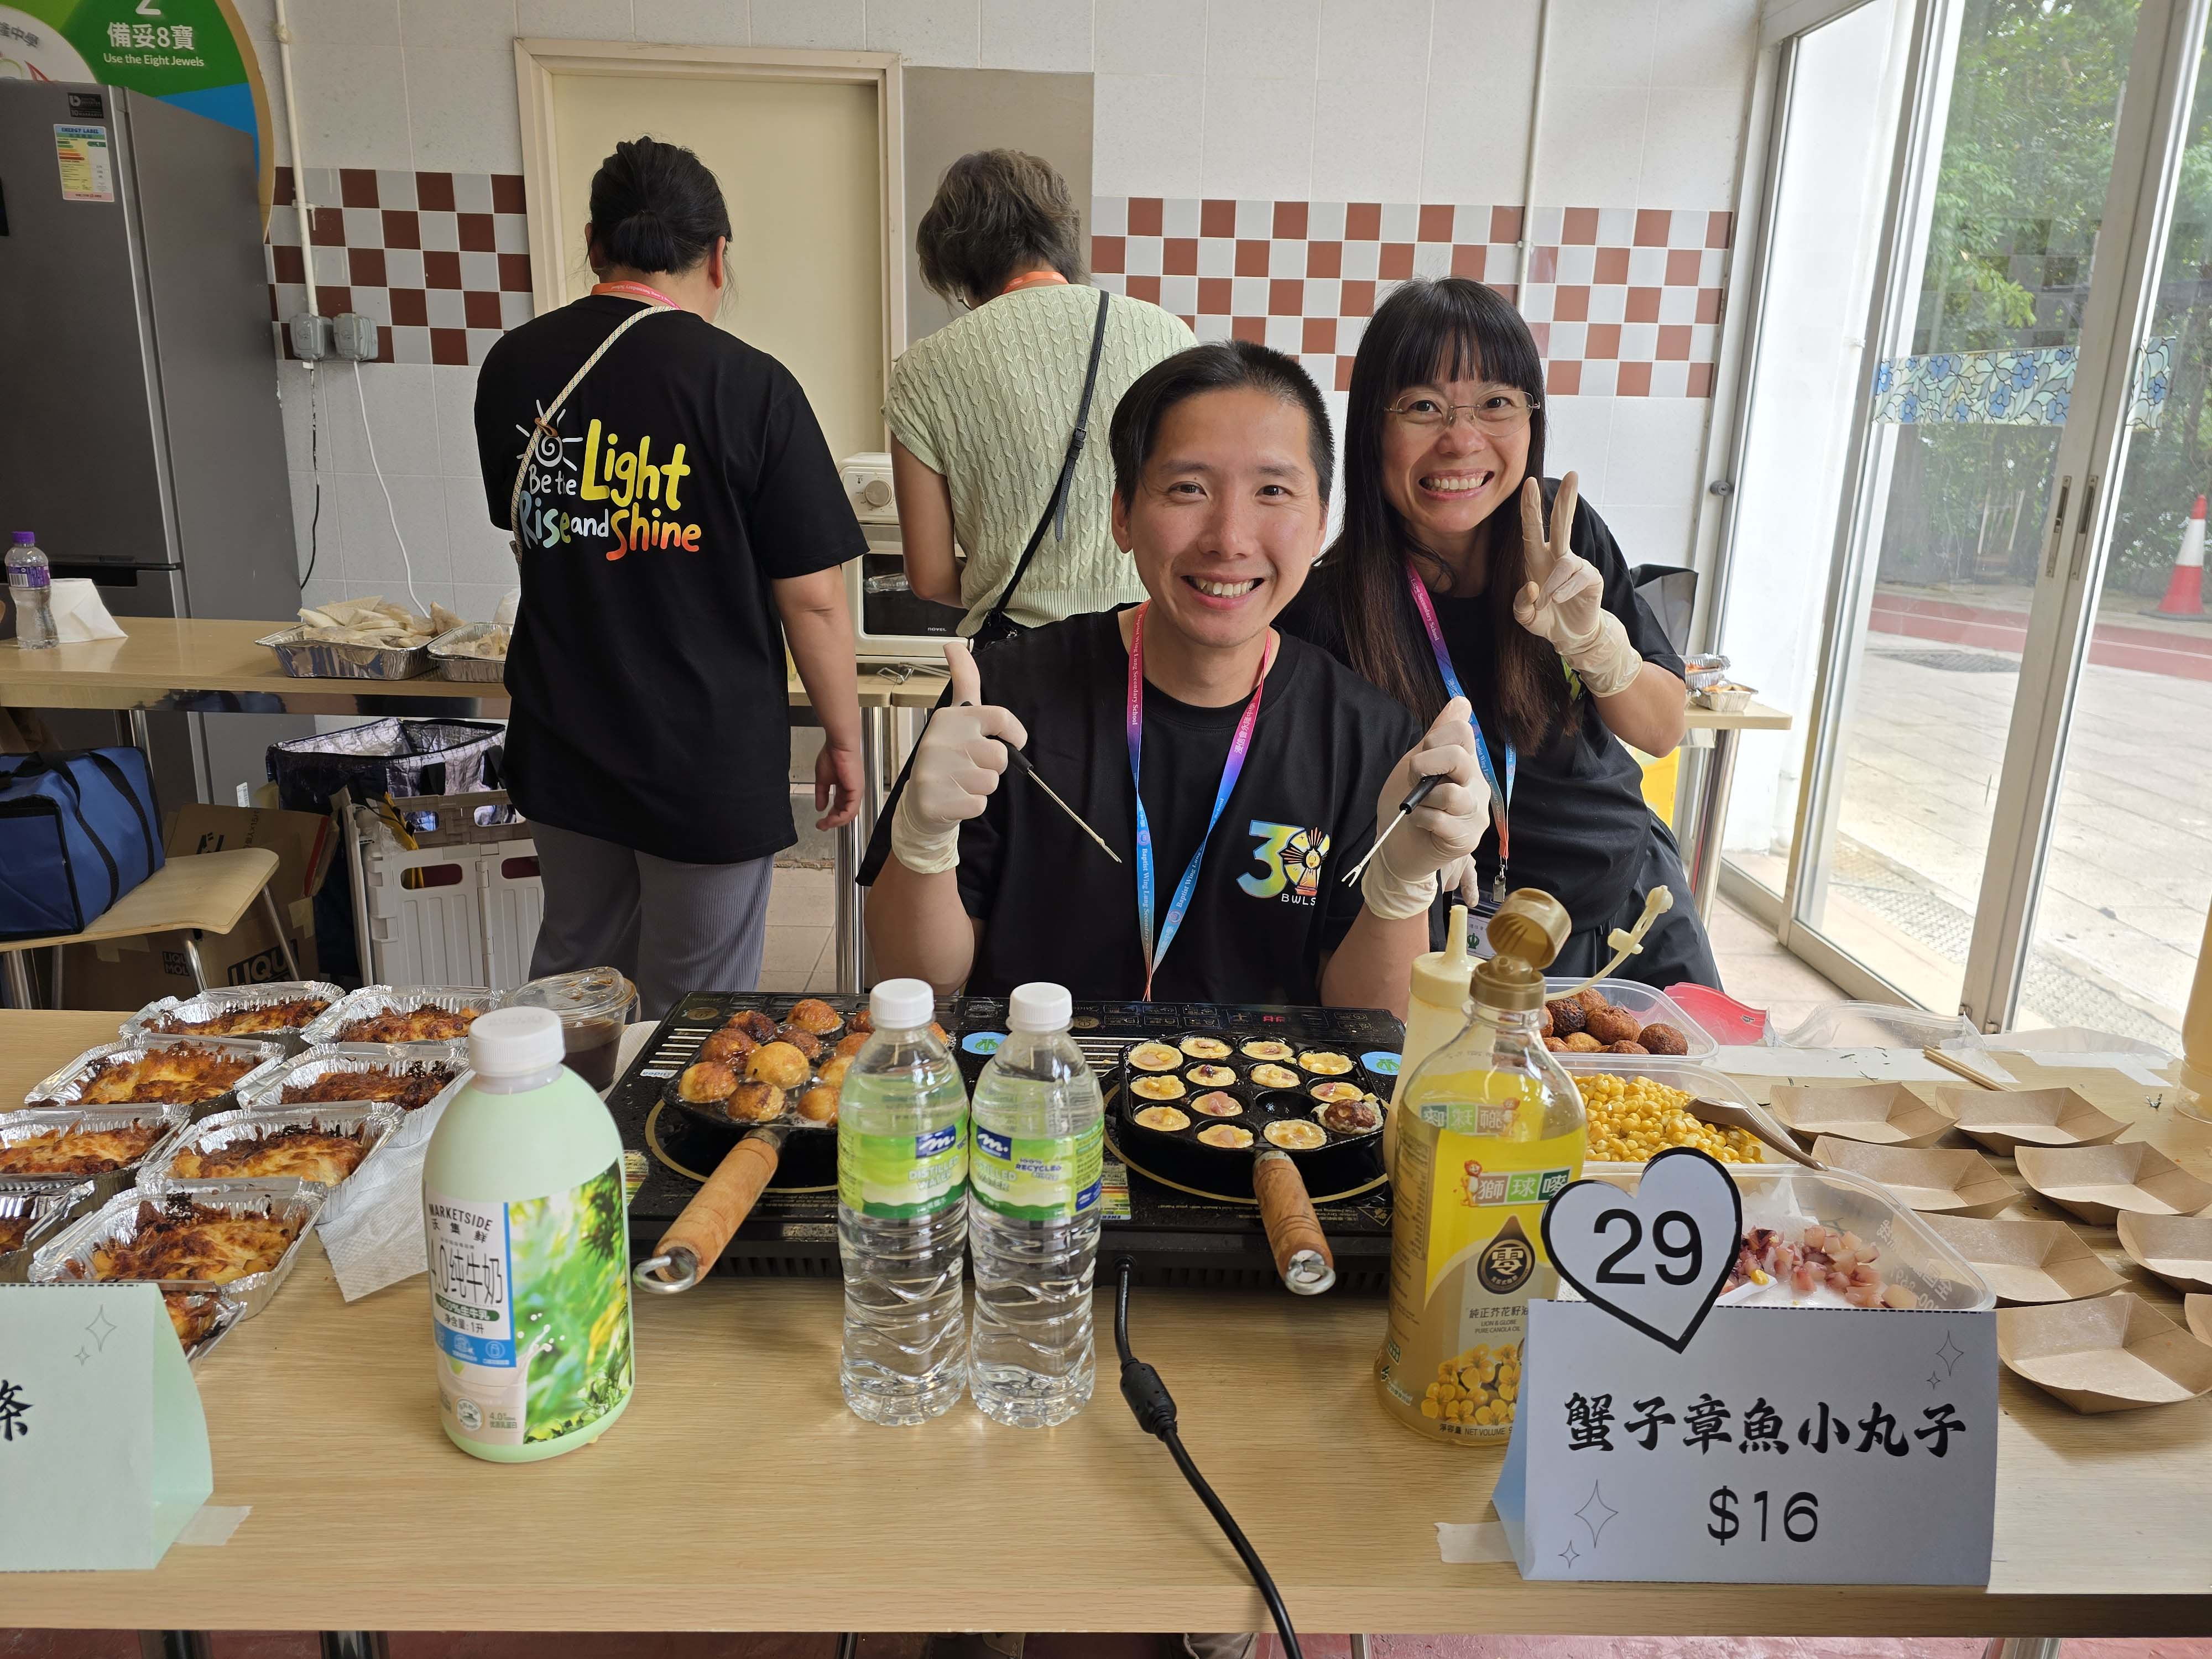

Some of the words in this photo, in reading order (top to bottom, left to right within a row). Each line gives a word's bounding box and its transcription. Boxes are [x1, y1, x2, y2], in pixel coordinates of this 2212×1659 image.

[107, 22, 195, 50] 備妥8寶
[103, 53, 123, 64] Use
[124, 54, 142, 65] the
[144, 55, 170, 67] Eight
[171, 57, 205, 67] Jewels
[529, 464, 551, 495] Be
[555, 471, 577, 496] the
[580, 419, 691, 511] Light
[519, 491, 571, 549] Rise
[571, 508, 608, 538] and
[606, 502, 702, 561] Shine
[1417, 592, 1432, 622] Secondary
[1430, 622, 1439, 641] School
[1176, 886, 1190, 909] Baptist
[1185, 868, 1196, 885] Wing
[164, 952, 187, 964] LIQU
[165, 964, 189, 975] MOL
[231, 947, 289, 987] LIQU
[908, 1155, 959, 1181] DISTILLED
[974, 1158, 1018, 1182] STILLED
[1015, 1164, 1062, 1172] RECYCLED
[1479, 1175, 1568, 1200] 獅球嘜
[429, 1204, 493, 1232] MARKETSIDE
[1490, 1246, 1524, 1276] 零
[1593, 1207, 1704, 1287] 29
[431, 1238, 503, 1305] 4.0纯牛奶
[1439, 1423, 1462, 1435] 淨容量
[1479, 1427, 1505, 1436] VOLUME
[1564, 1391, 1967, 1459] 蟹子章魚小丸子
[1707, 1485, 1819, 1546] $16
